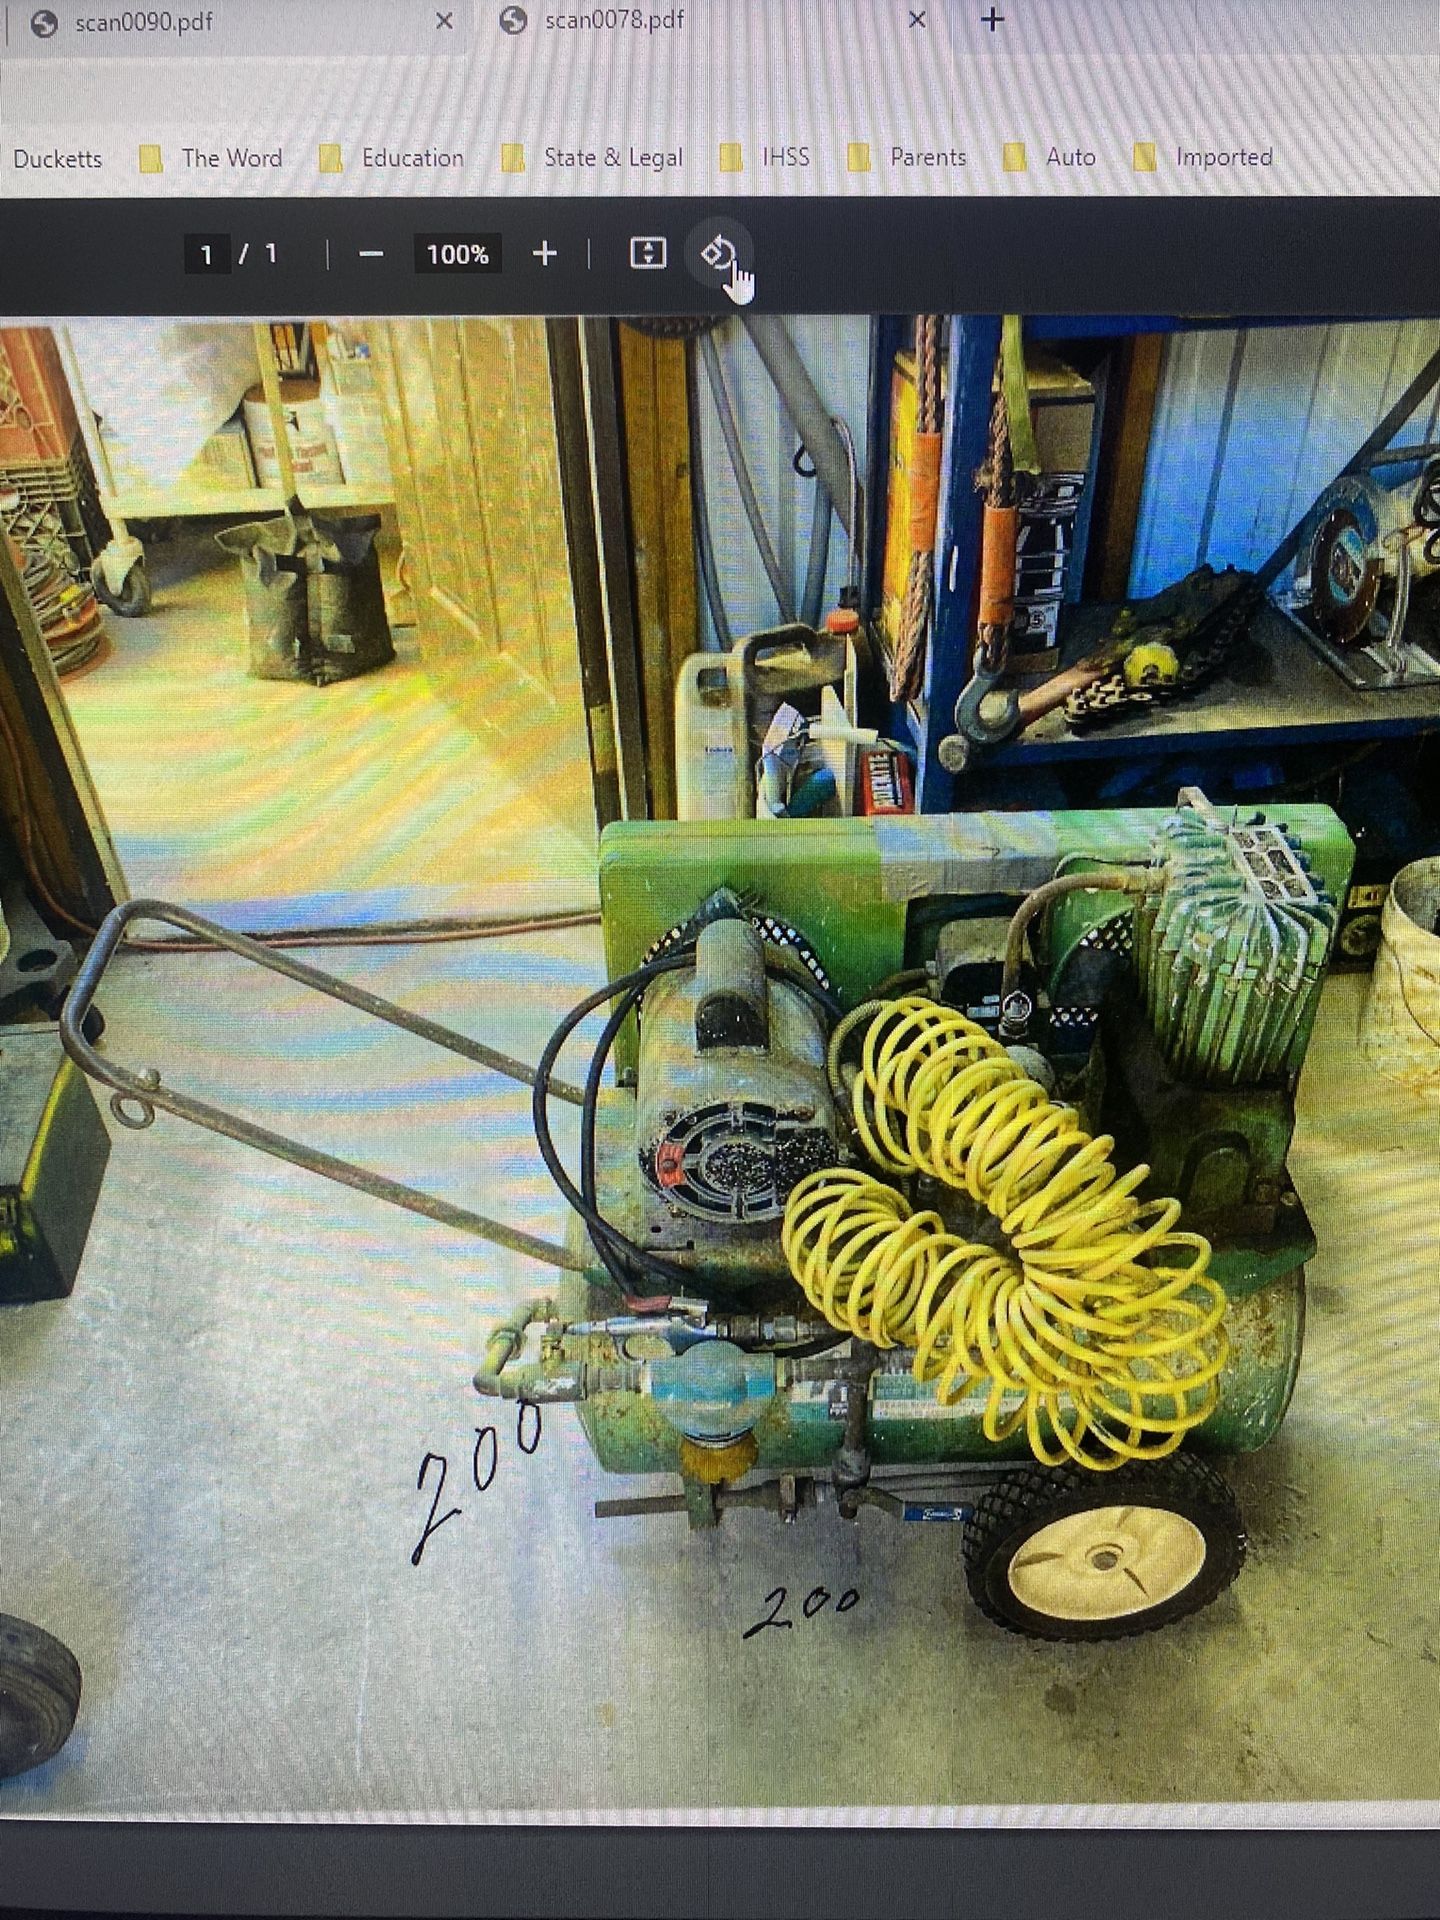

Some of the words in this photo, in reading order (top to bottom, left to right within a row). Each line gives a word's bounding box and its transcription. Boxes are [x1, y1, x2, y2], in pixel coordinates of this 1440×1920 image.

[76, 11, 213, 37] scan0090.pdf
[545, 8, 685, 34] scan0078.pdf
[13, 148, 103, 169] Ducketts
[181, 147, 220, 168] The
[226, 147, 283, 168] Word
[362, 147, 464, 168] Education
[545, 146, 597, 168] State
[603, 146, 622, 168] &
[629, 146, 683, 173] Legal
[762, 146, 810, 167] IHSS
[891, 146, 967, 167] Parents
[1045, 146, 1096, 167] Auto
[1176, 146, 1273, 172] Imported
[200, 244, 211, 265] 1
[265, 242, 276, 263] 1
[427, 243, 490, 265] 100%
[411, 1400, 542, 1567] 200
[742, 1585, 860, 1640] 200
